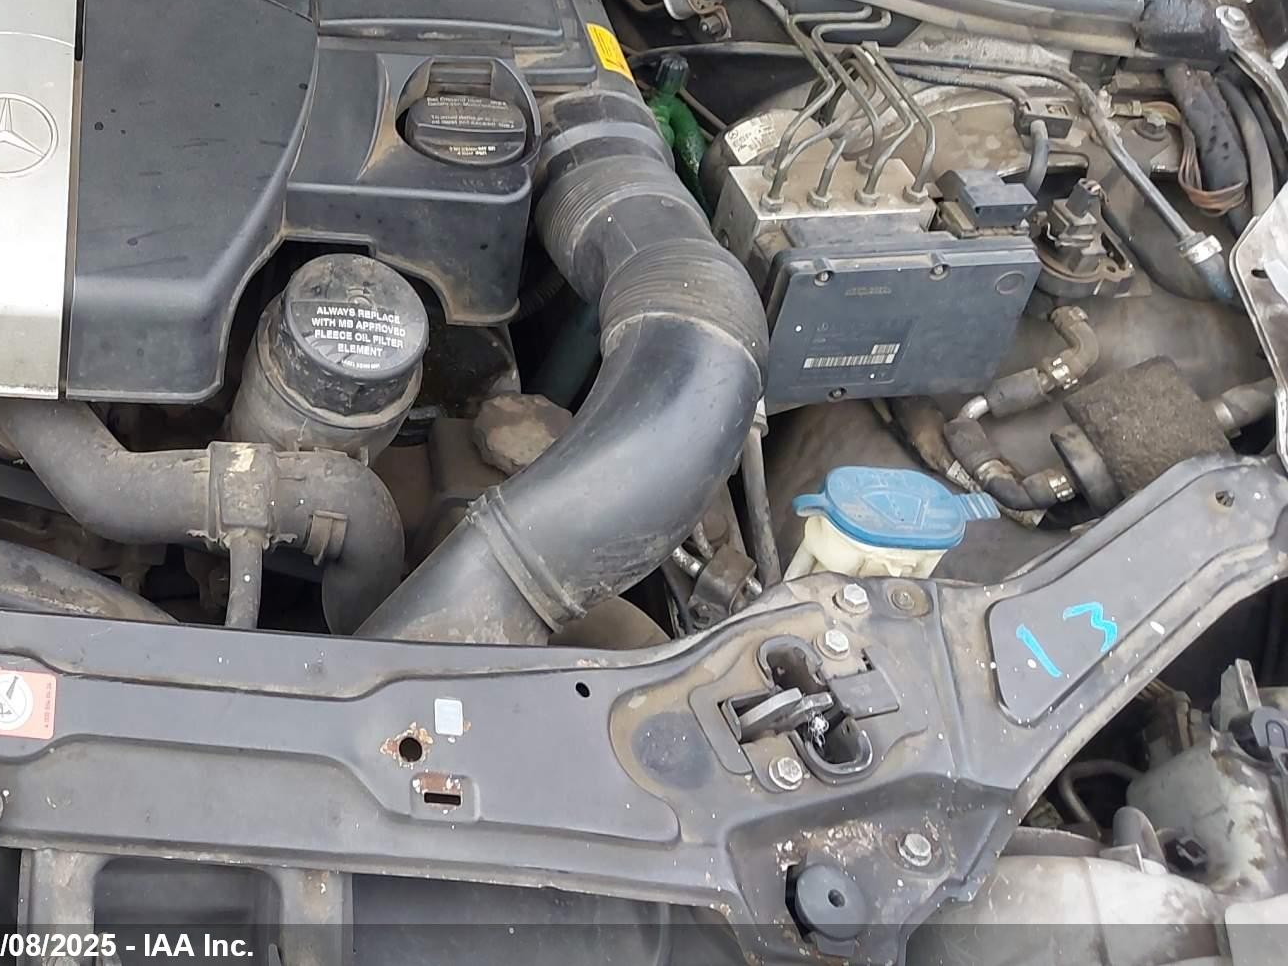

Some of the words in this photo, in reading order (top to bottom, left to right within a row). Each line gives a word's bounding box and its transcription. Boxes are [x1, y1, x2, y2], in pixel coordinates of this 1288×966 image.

[316, 305, 356, 317] ALWAYS
[357, 308, 401, 325] REPLACE
[311, 317, 337, 328] WITH
[338, 318, 354, 329] MB
[355, 320, 407, 338] APPROVED
[314, 328, 353, 340] FLEECE
[354, 332, 372, 343] OIL
[372, 334, 404, 350] FILTER
[337, 342, 384, 358] ELEMENT
